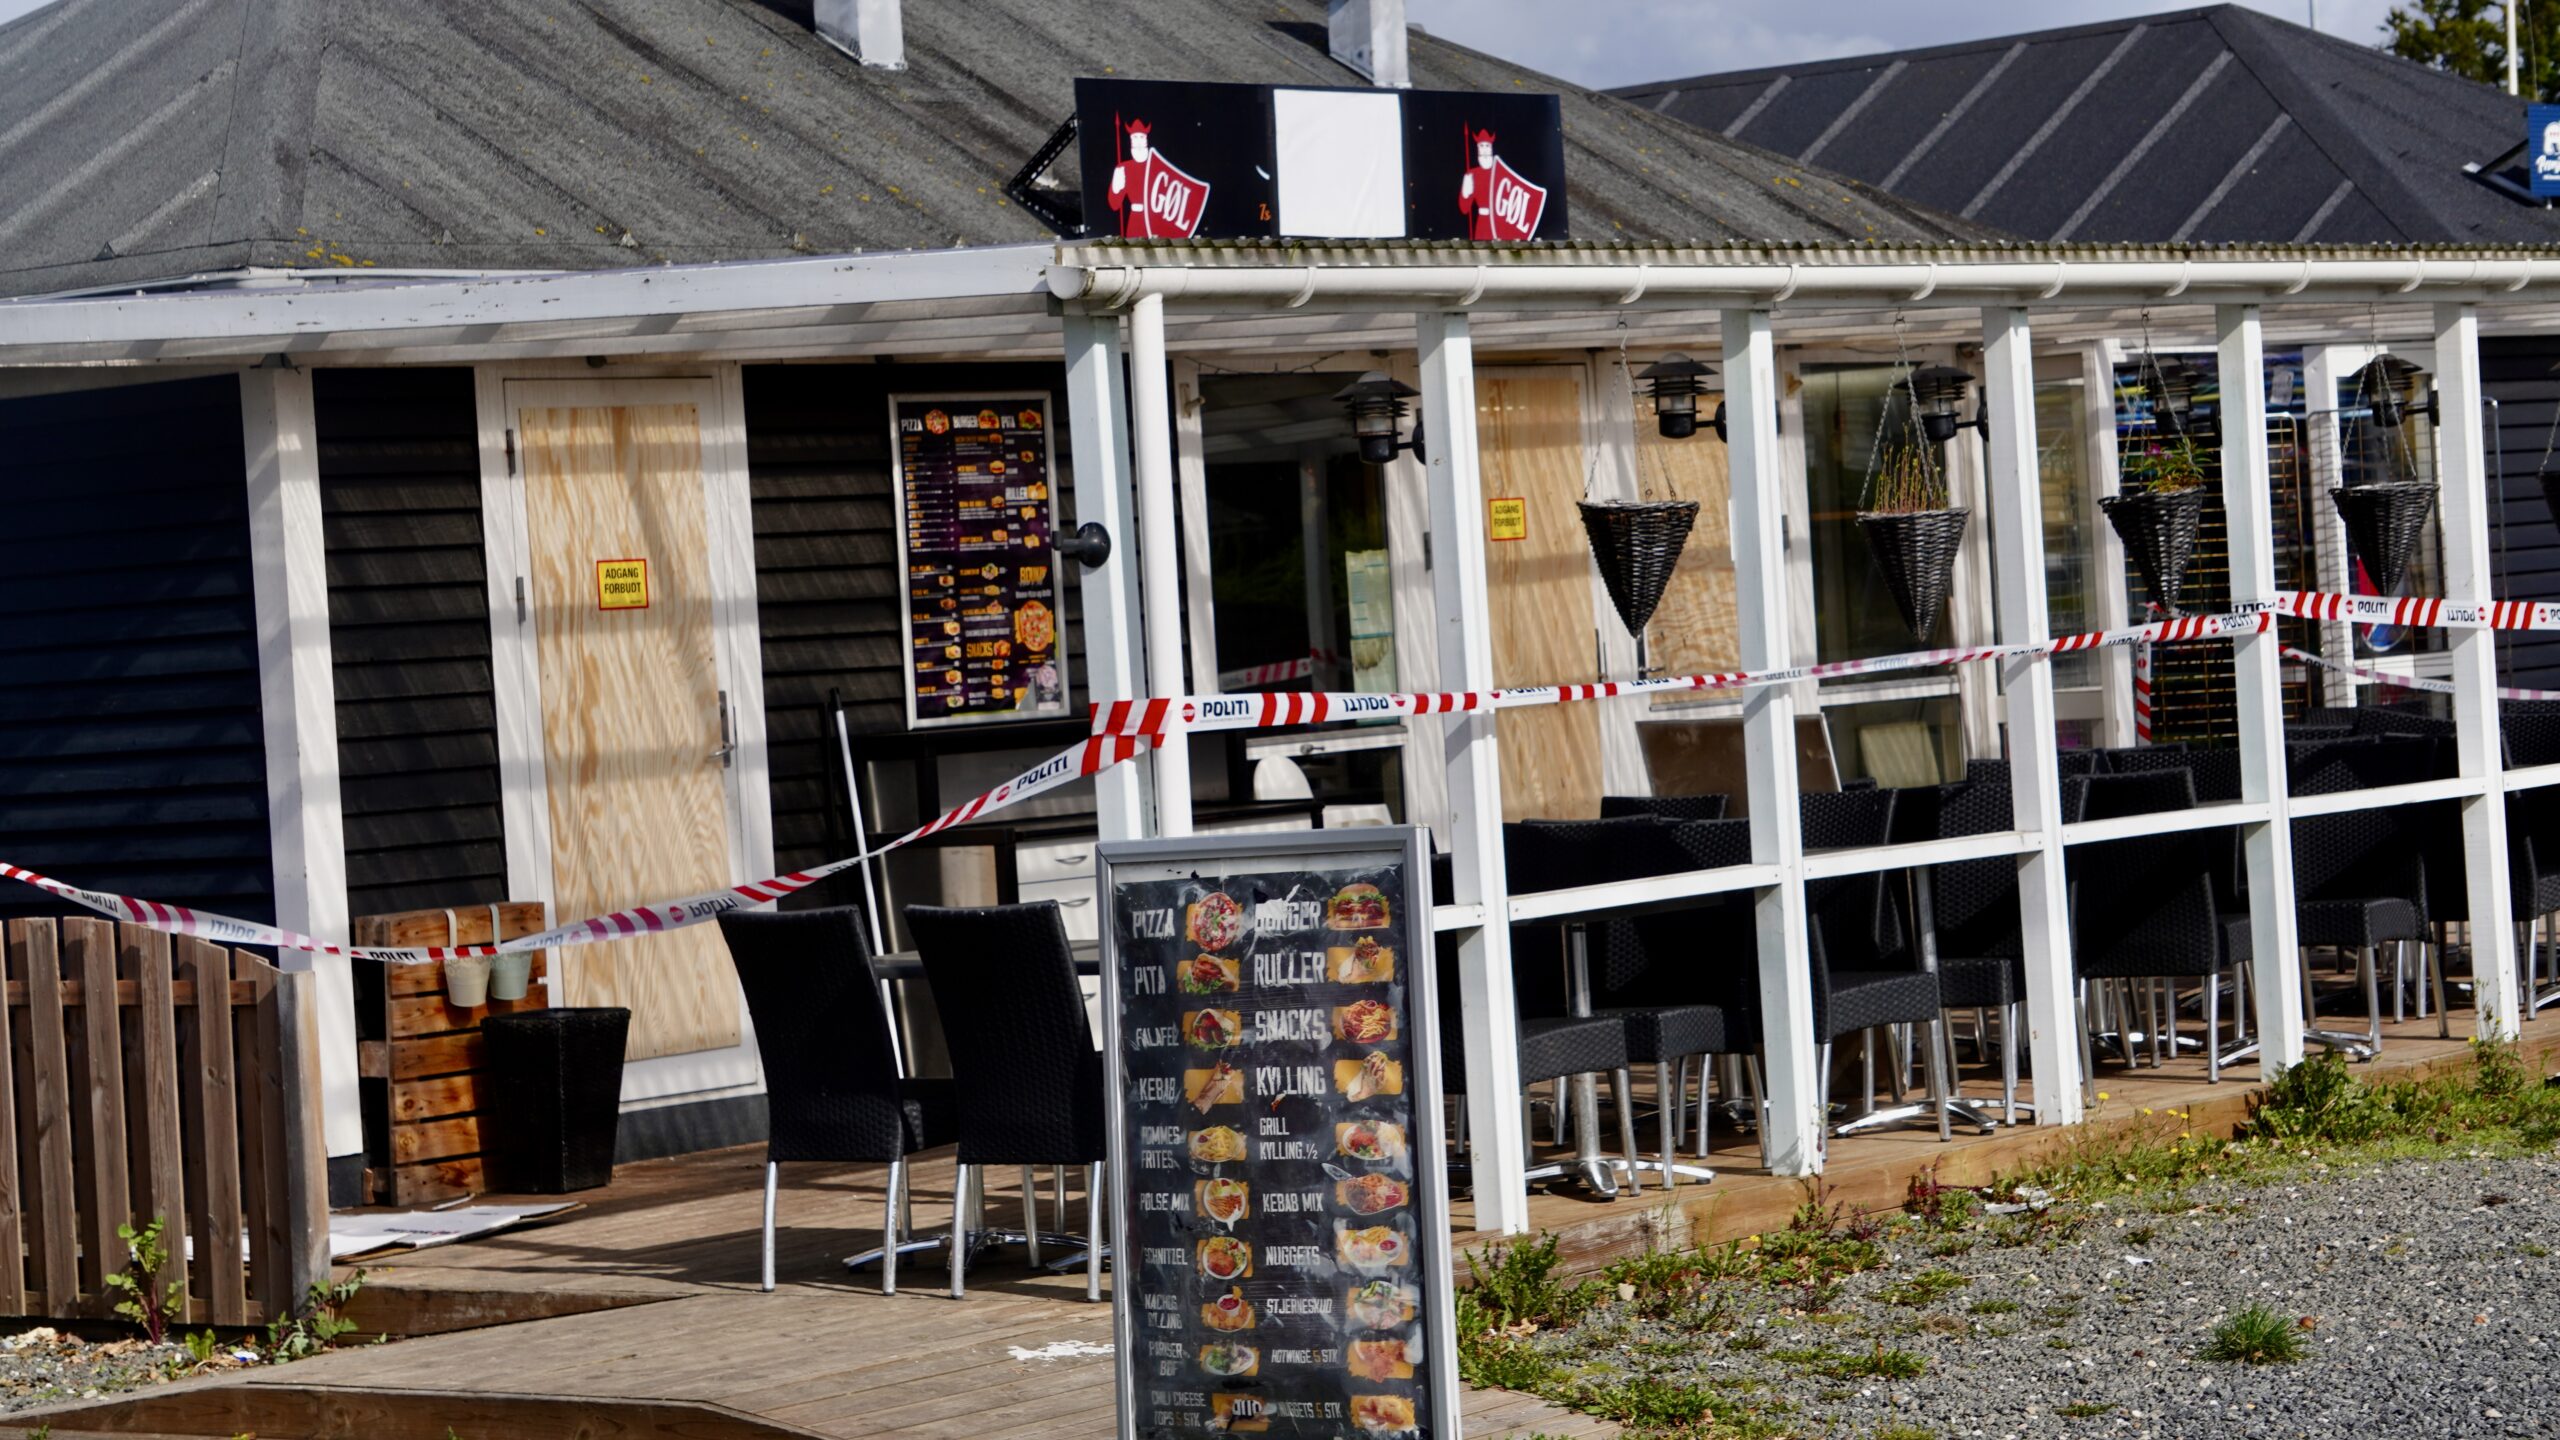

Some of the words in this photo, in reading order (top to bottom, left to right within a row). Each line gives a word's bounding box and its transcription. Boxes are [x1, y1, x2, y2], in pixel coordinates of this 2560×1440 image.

[1151, 171, 1191, 231] GØL
[1495, 177, 1531, 233] GØL
[901, 418, 923, 432] PIZZA
[605, 568, 639, 579] ADGANG
[604, 582, 641, 594] FORBUDT
[2358, 600, 2388, 613] POLITI
[2446, 609, 2476, 622] POLITI
[2222, 614, 2253, 629] POLITI
[1203, 700, 1249, 717] POLITI
[1343, 697, 1389, 712] POLITI
[1017, 755, 1068, 790] POLITI
[1132, 908, 1175, 939] PIZZA
[1254, 952, 1325, 986] RULLER
[1134, 965, 1166, 995] PITA
[1255, 1009, 1327, 1041] SNACKS
[1135, 1026, 1179, 1049] FALAFEL
[1139, 1077, 1176, 1102] KEBAB
[1256, 1066, 1327, 1096] KYLLING
[1260, 1117, 1290, 1135] GRILL
[1141, 1126, 1180, 1145] POMMES
[1141, 1150, 1174, 1169] FRITES
[1171, 1193, 1190, 1211] MIX
[1263, 1193, 1299, 1212] KEBAB
[1302, 1193, 1324, 1212] MIX
[1265, 1245, 1320, 1266] NUGGETS
[1266, 1298, 1332, 1314] STJERNESKUD
[1312, 1349, 1321, 1363] 5
[1321, 1349, 1338, 1363] STK
[1173, 1391, 1206, 1407] CHEESE
[1279, 1401, 1314, 1418] NUGGETS
[1315, 1402, 1324, 1418] 5
[1324, 1402, 1342, 1418] STK
[1183, 1412, 1201, 1427] STK
